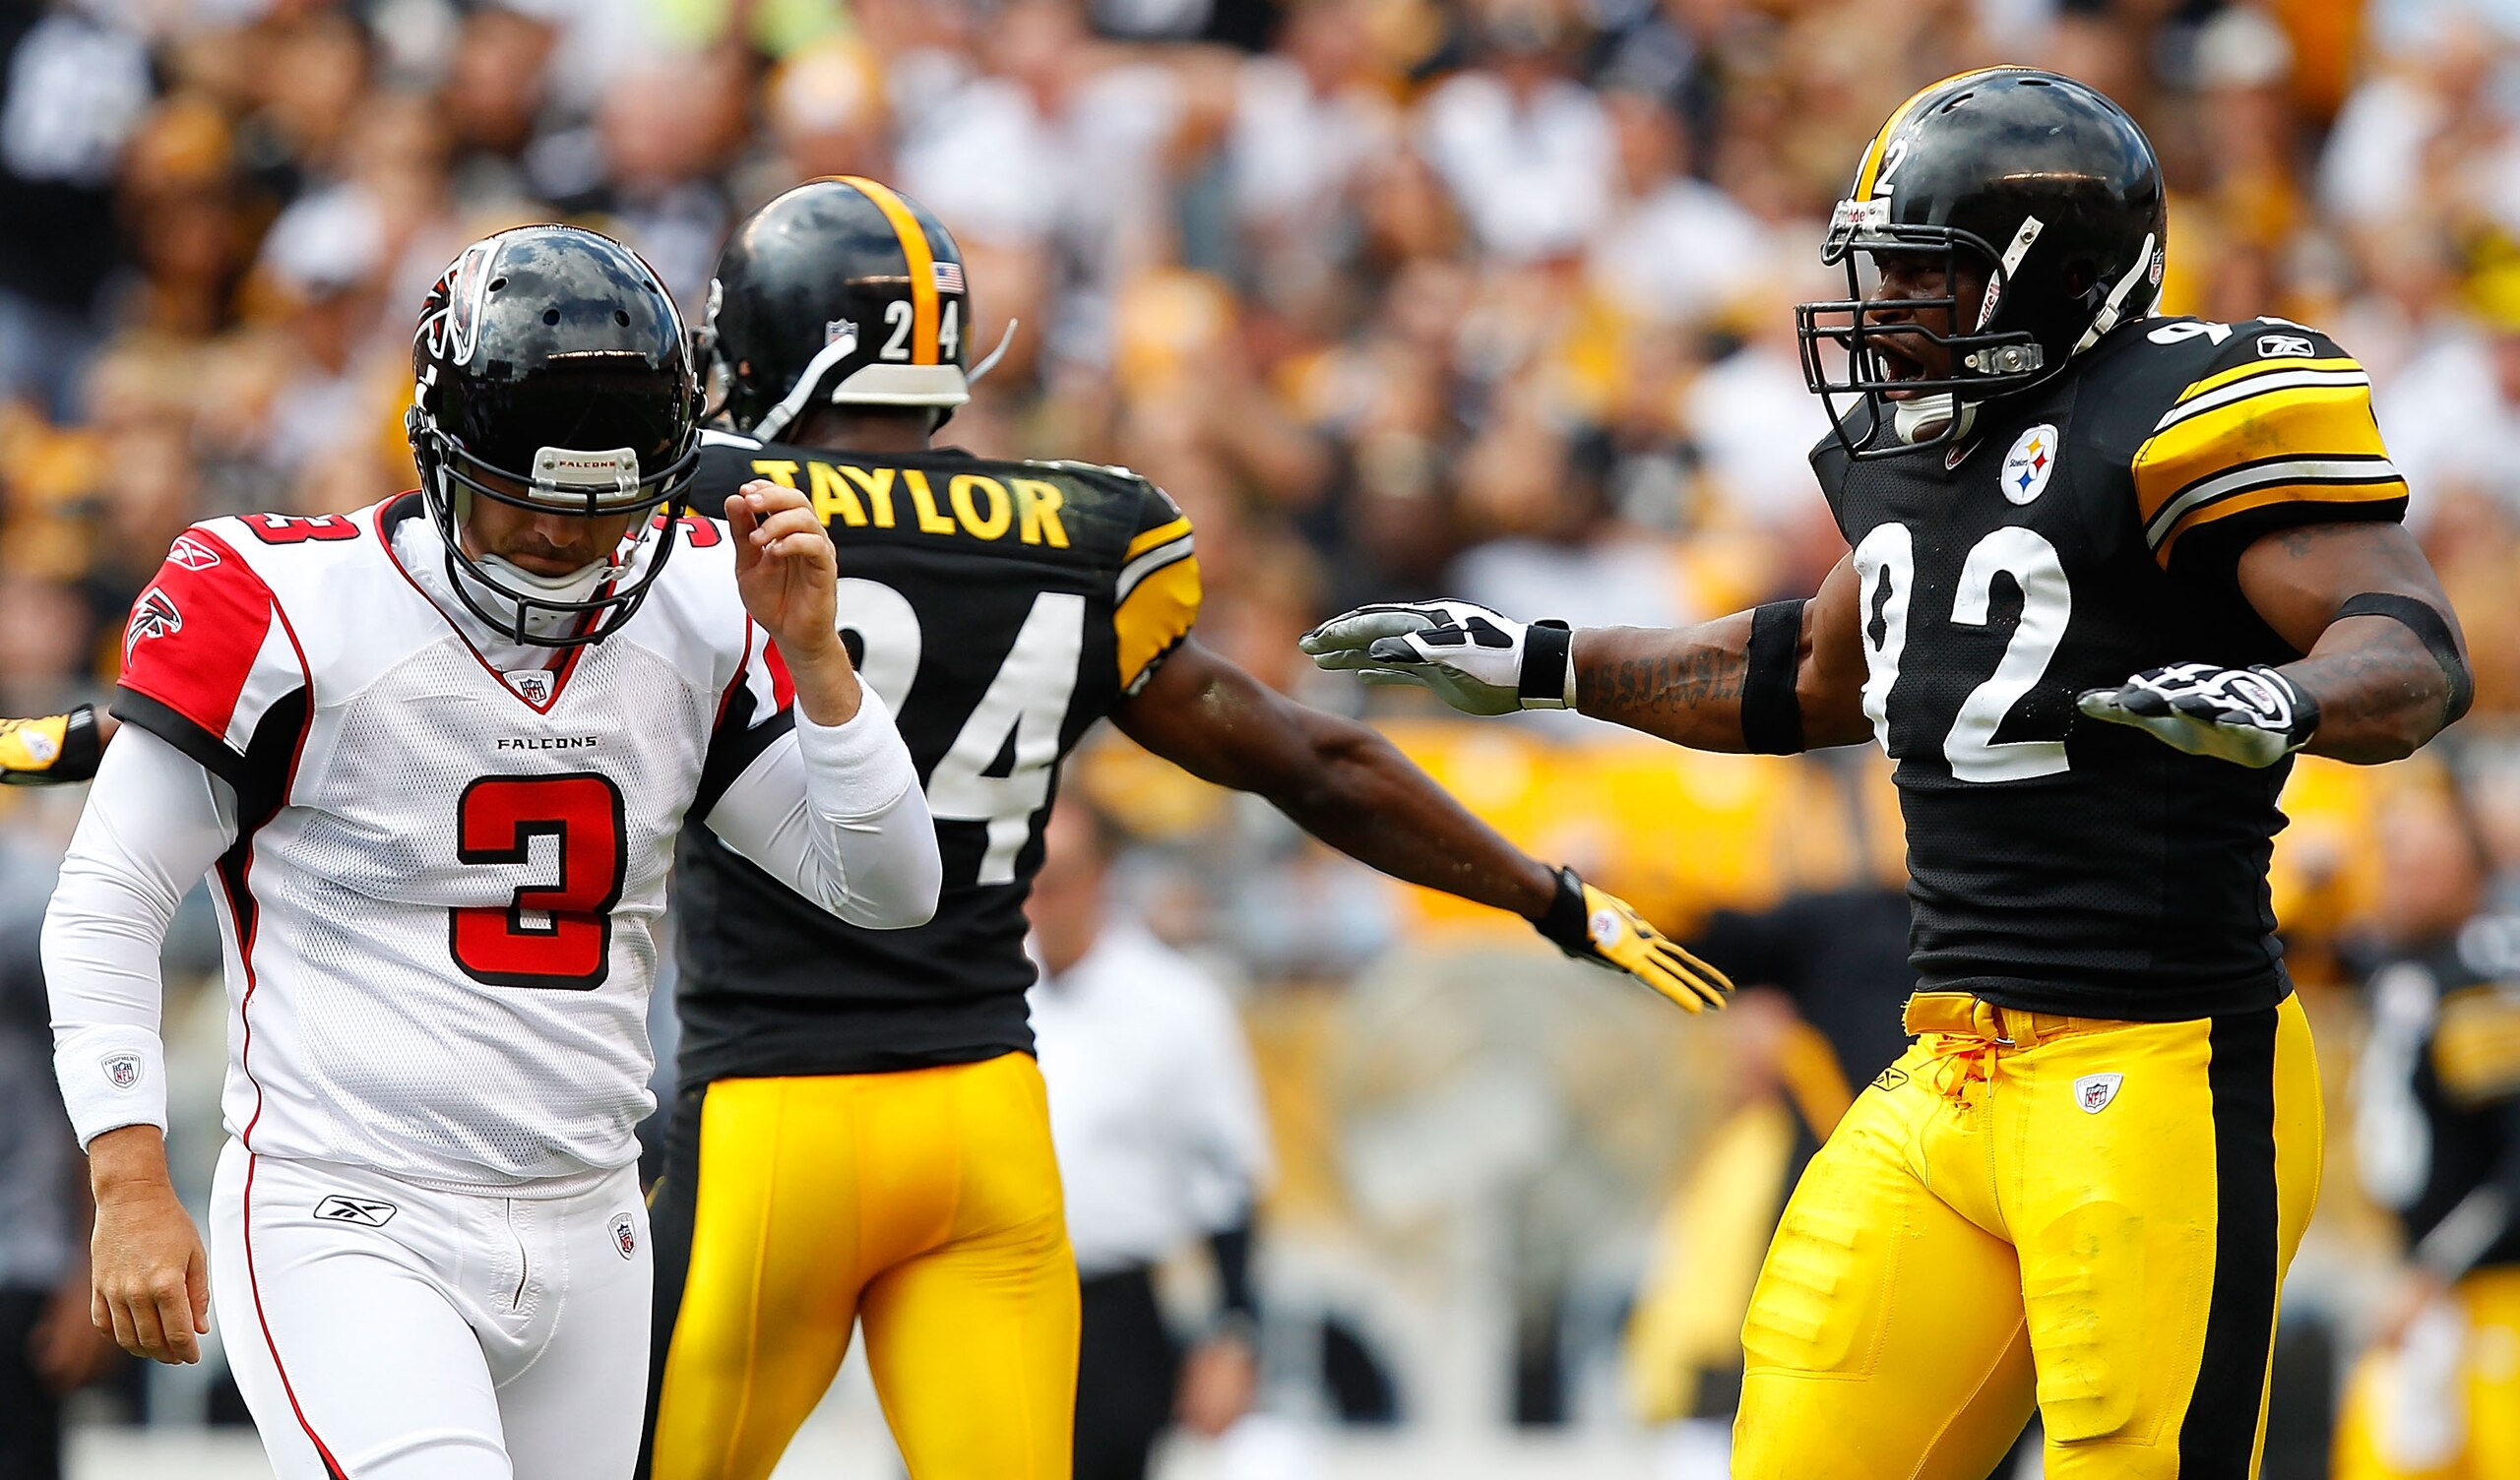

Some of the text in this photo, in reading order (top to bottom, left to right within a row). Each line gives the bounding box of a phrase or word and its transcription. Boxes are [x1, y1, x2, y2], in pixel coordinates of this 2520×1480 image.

[879, 300, 959, 360] 24
[751, 460, 1071, 549] TAYLOR
[1853, 522, 2071, 783] 92
[526, 688, 547, 701] NFL
[497, 736, 598, 750] FALCONS
[449, 771, 628, 991] 3
[104, 1056, 138, 1066] EQUIPMENT
[115, 1070, 134, 1082] NFL
[2087, 1091, 2107, 1105] NFL
